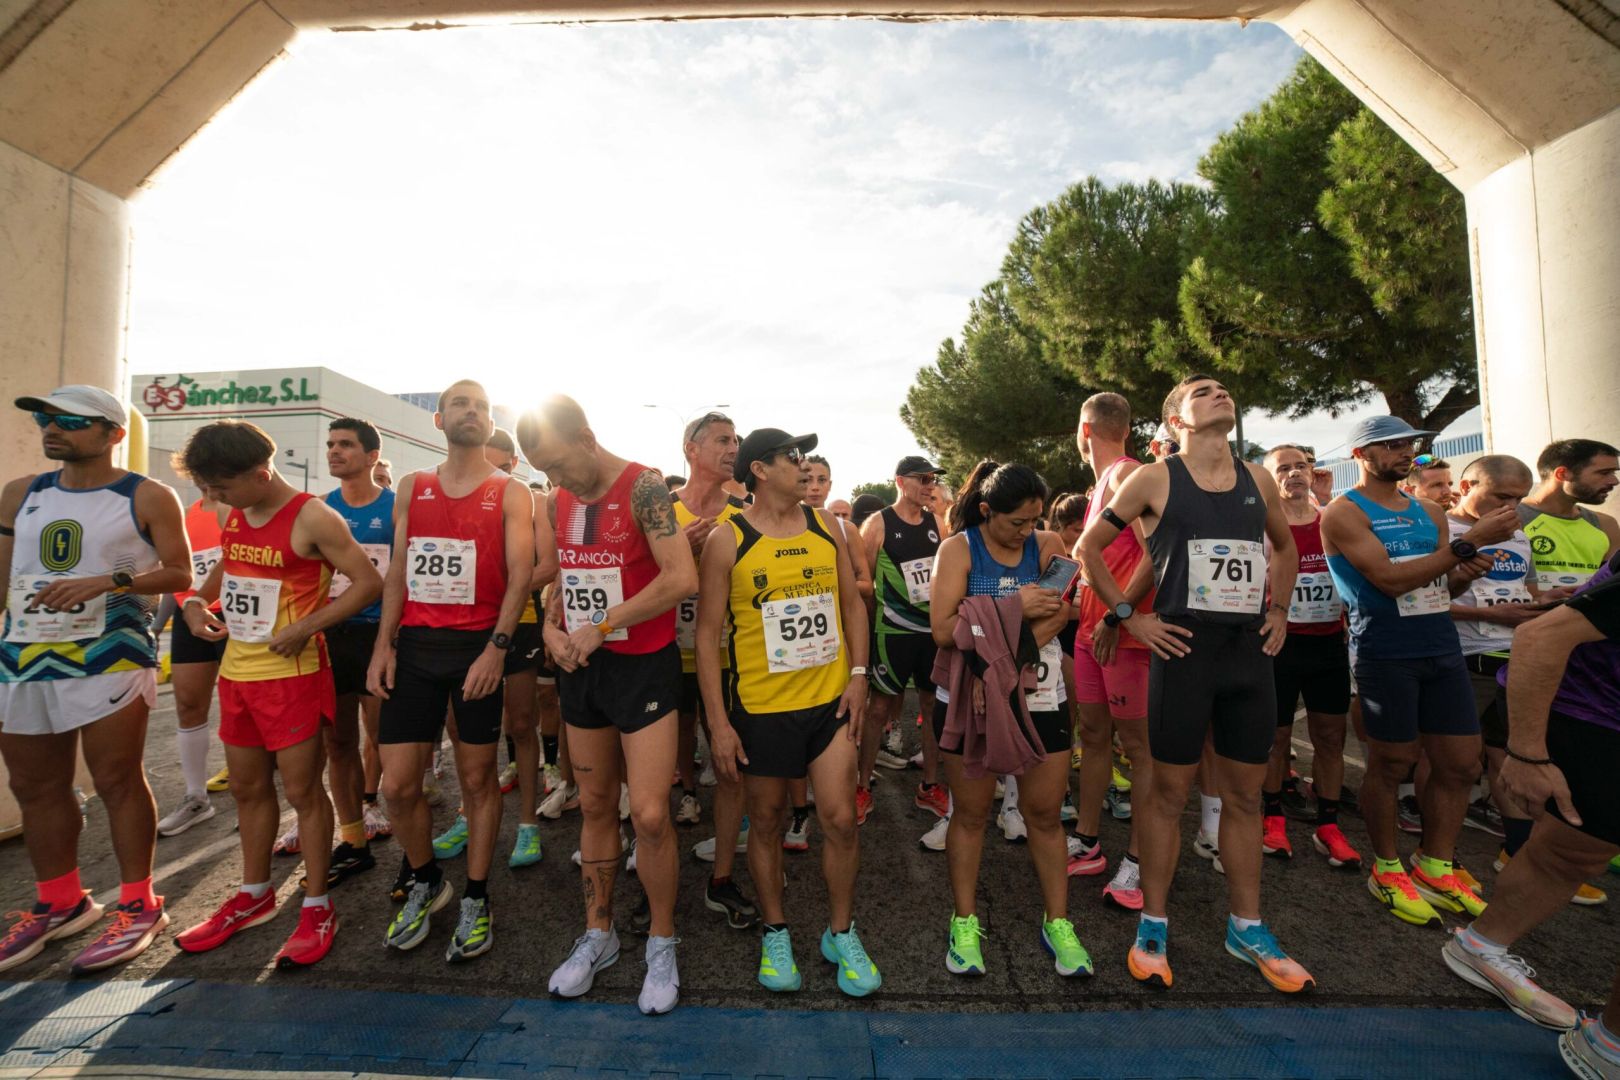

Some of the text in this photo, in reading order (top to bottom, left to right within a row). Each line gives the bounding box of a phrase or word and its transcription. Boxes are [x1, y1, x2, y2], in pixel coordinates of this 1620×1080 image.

[280, 378, 319, 401] S.L.
[229, 543, 284, 567] SESEÑA
[414, 554, 462, 577] 285
[557, 549, 624, 565] TARANCÓN
[1209, 558, 1252, 583] 761
[225, 591, 260, 616] 251
[565, 588, 608, 611] 259
[1294, 585, 1333, 602] 1127
[779, 612, 828, 642] 529
